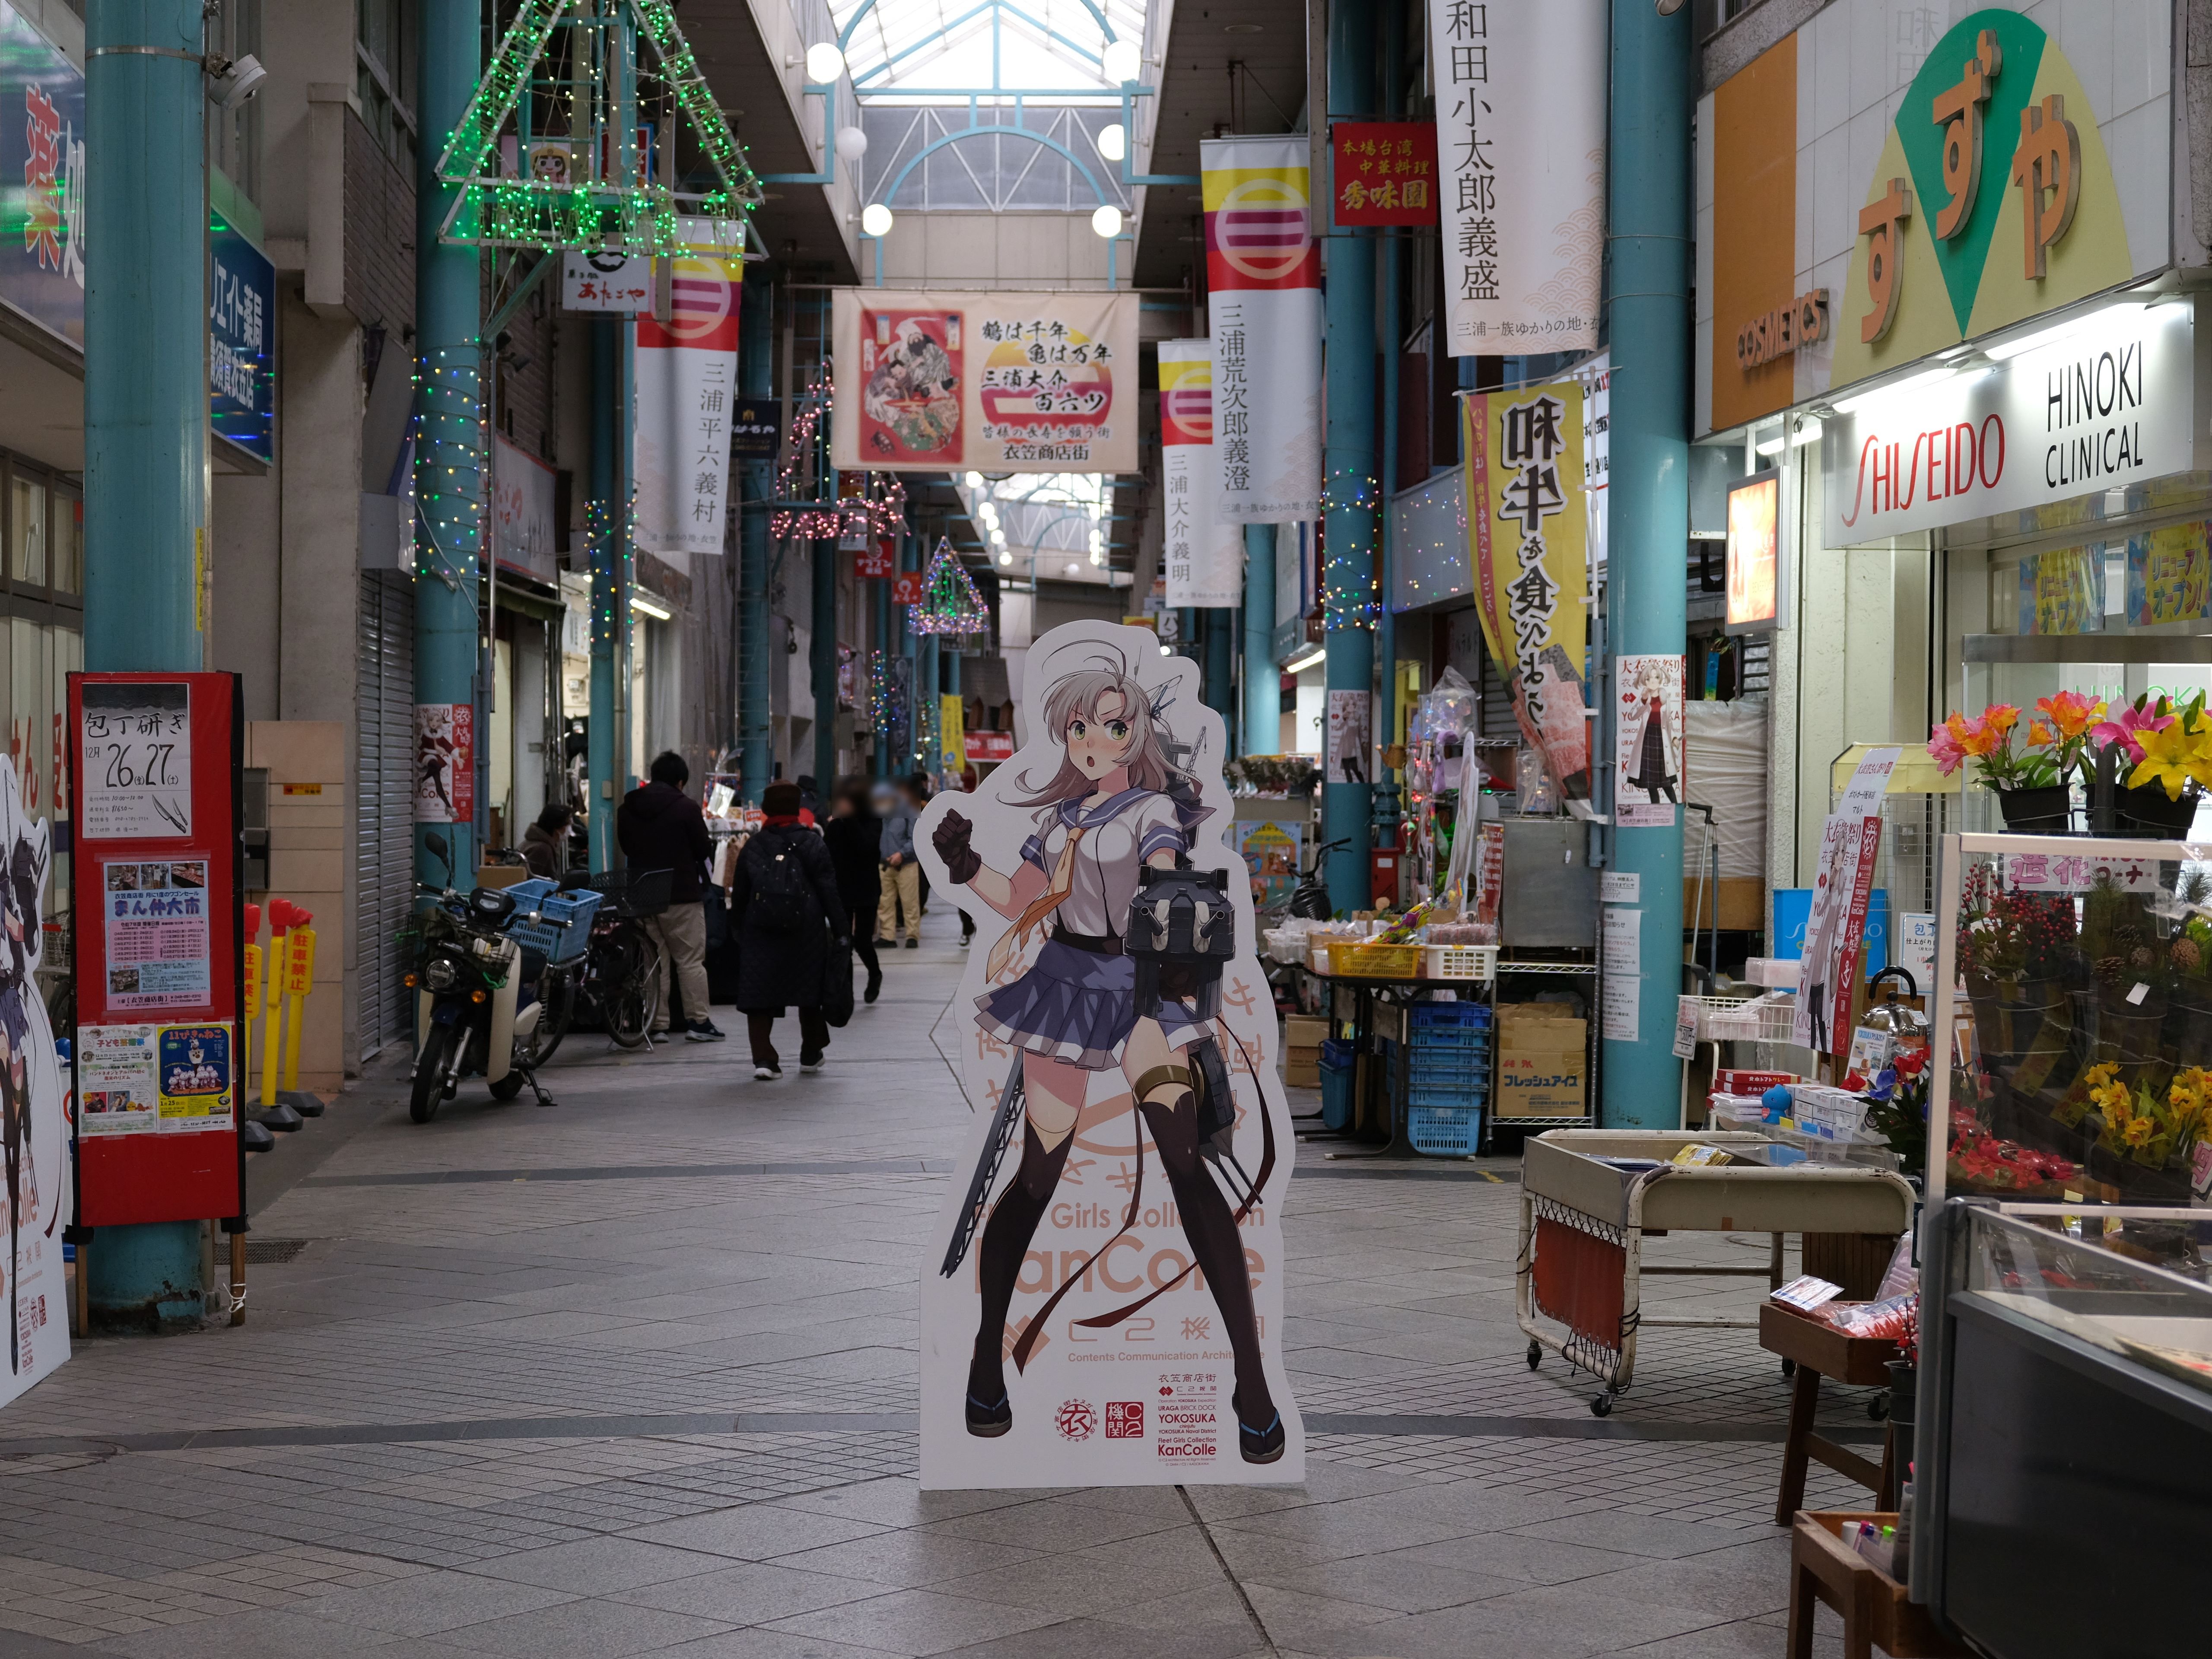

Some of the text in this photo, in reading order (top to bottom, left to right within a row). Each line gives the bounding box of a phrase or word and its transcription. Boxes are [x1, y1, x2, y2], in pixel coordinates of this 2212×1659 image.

[1446, 0, 1500, 301] 和田小太郎義盛
[1859, 30, 2082, 344] すずや
[1738, 288, 1830, 371] COSMETICS
[2048, 340, 2142, 432] HINOKI
[692, 362, 725, 523] 三浦平六義村
[1003, 445, 1089, 461] 衣笠商店街
[2046, 422, 2143, 488] CLINICAL
[1842, 413, 2005, 527] SHISEIDO
[85, 712, 186, 738] 包丁研ぎ
[290, 934, 308, 990] 駐車禁止
[1503, 1074, 1578, 1087] フレッシュアイス
[1051, 1202, 1110, 1229] Girls
[1068, 1353, 1116, 1362] Contents
[1118, 1351, 1198, 1362] Communication
[1158, 1373, 1217, 1383] 衣笠商店街
[1159, 1414, 1216, 1423] YOKOSUKA
[1158, 1443, 1217, 1456] KanColle
